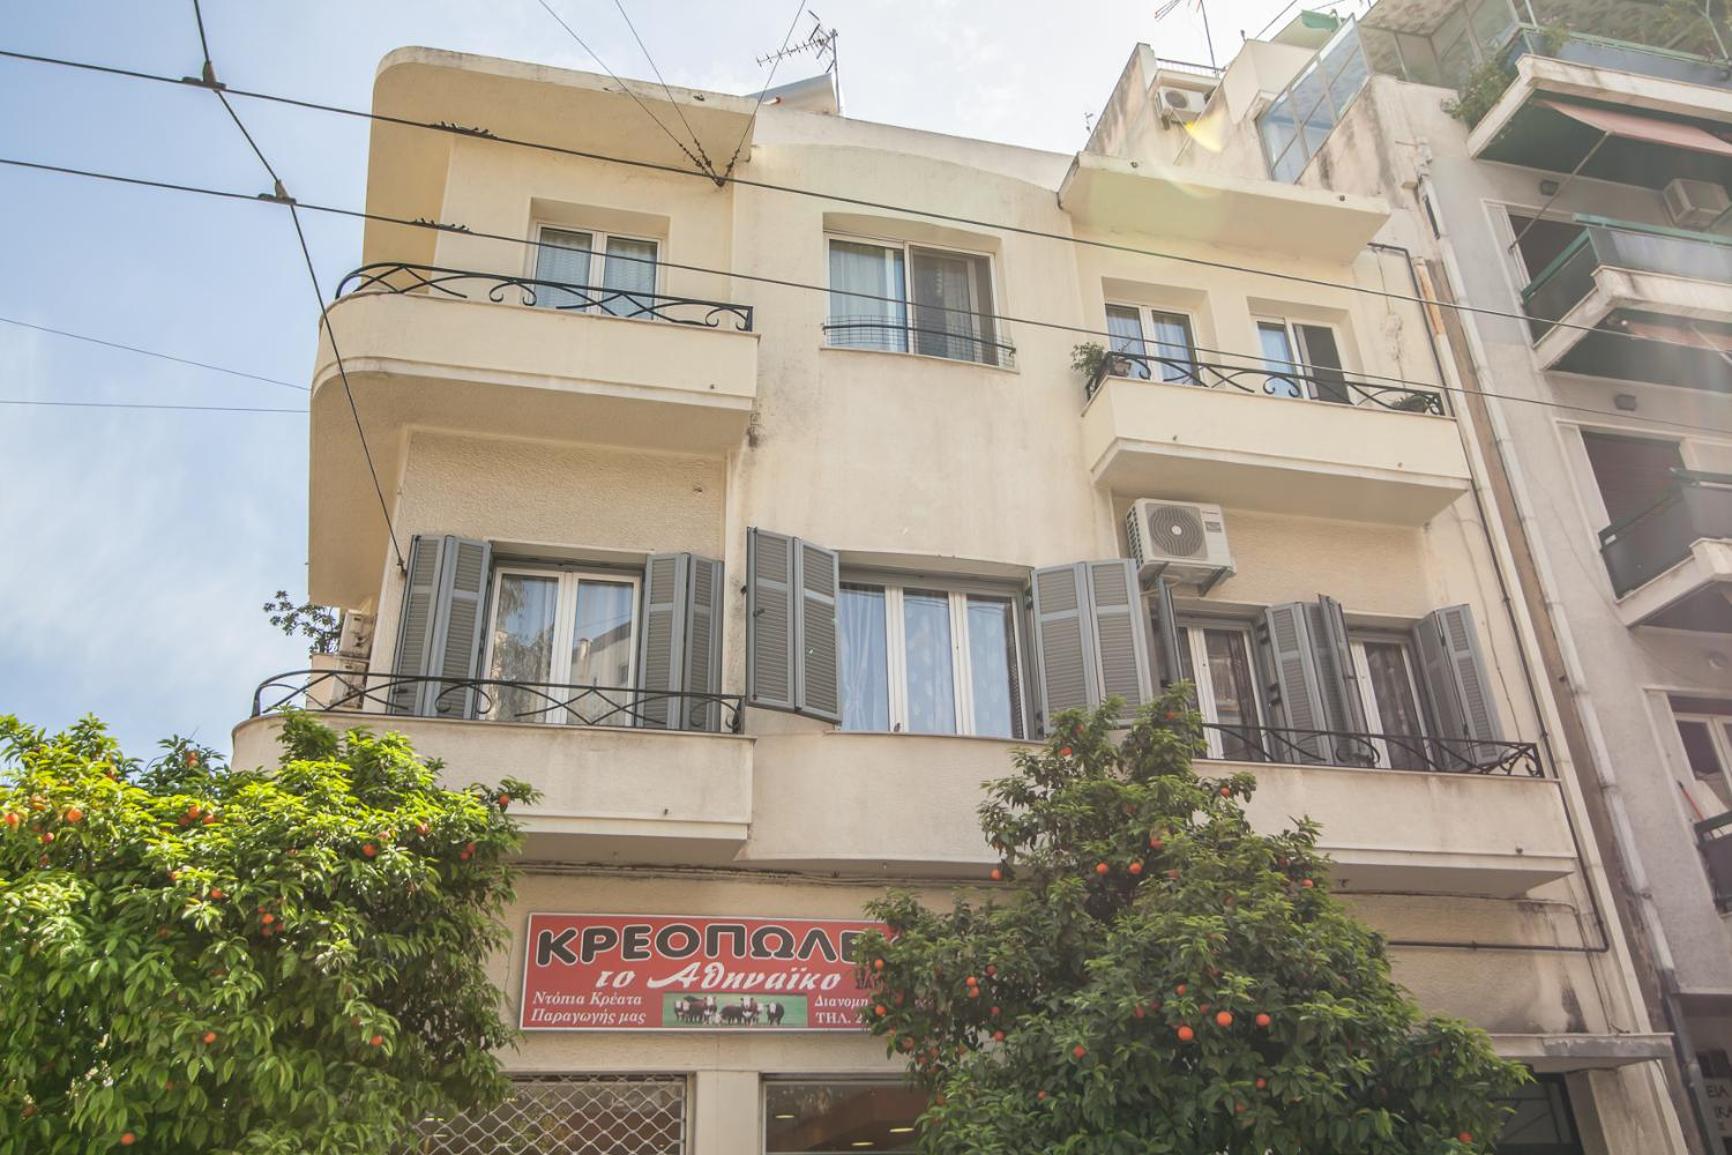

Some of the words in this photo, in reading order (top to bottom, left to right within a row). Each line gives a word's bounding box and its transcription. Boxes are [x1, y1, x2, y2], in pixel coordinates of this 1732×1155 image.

[537, 923, 868, 966] ΚΡΕΟΠΩΛΕ
[532, 991, 585, 1005] Ντόπια
[588, 991, 642, 1007] Κρέατα
[531, 1008, 616, 1025] Παραγωγής
[619, 1013, 647, 1025] μας
[815, 1012, 851, 1024] ΤΗΛ.
